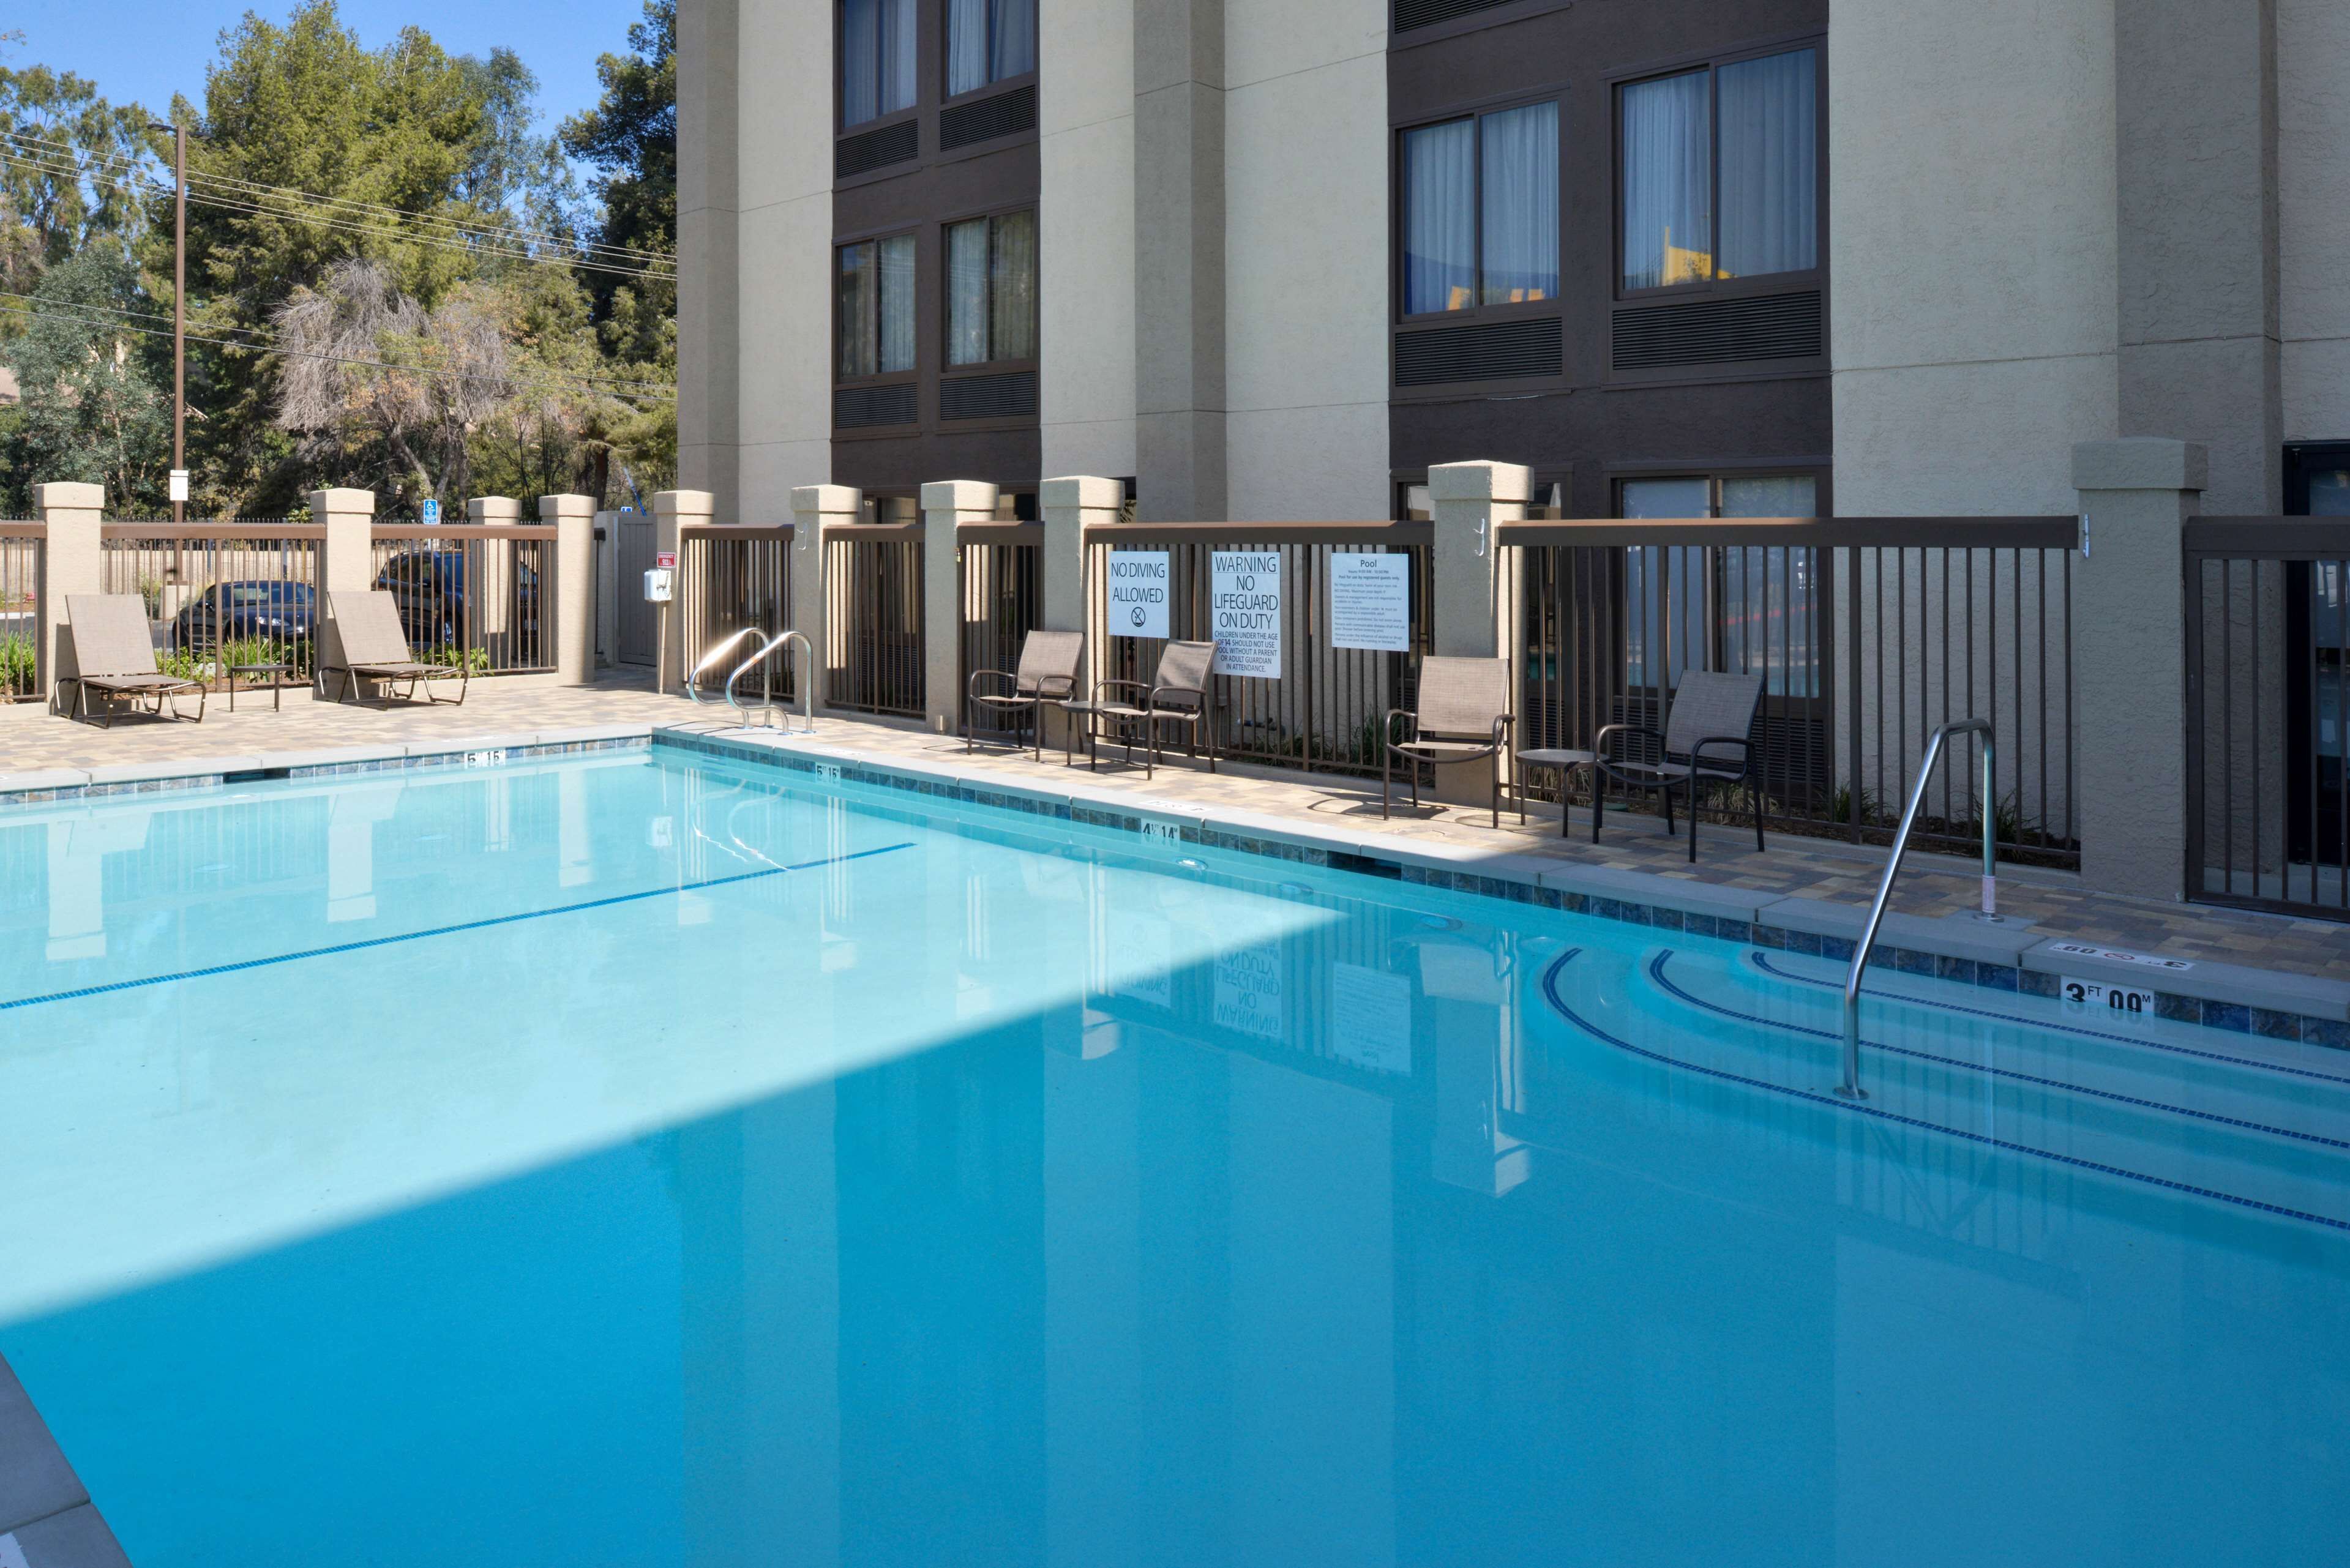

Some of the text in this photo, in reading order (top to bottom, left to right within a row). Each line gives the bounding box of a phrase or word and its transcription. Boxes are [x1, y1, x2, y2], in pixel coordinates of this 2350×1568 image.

[1112, 562, 1165, 578] NO DIVING
[1215, 556, 1276, 572] WARNING
[1237, 575, 1254, 591] NO
[1113, 587, 1164, 603] ALLOWED
[1214, 594, 1278, 610] LIFEGUARD
[1219, 612, 1273, 629] ON DUTY
[2066, 983, 2086, 1002] 3
[2088, 985, 2101, 997] FT
